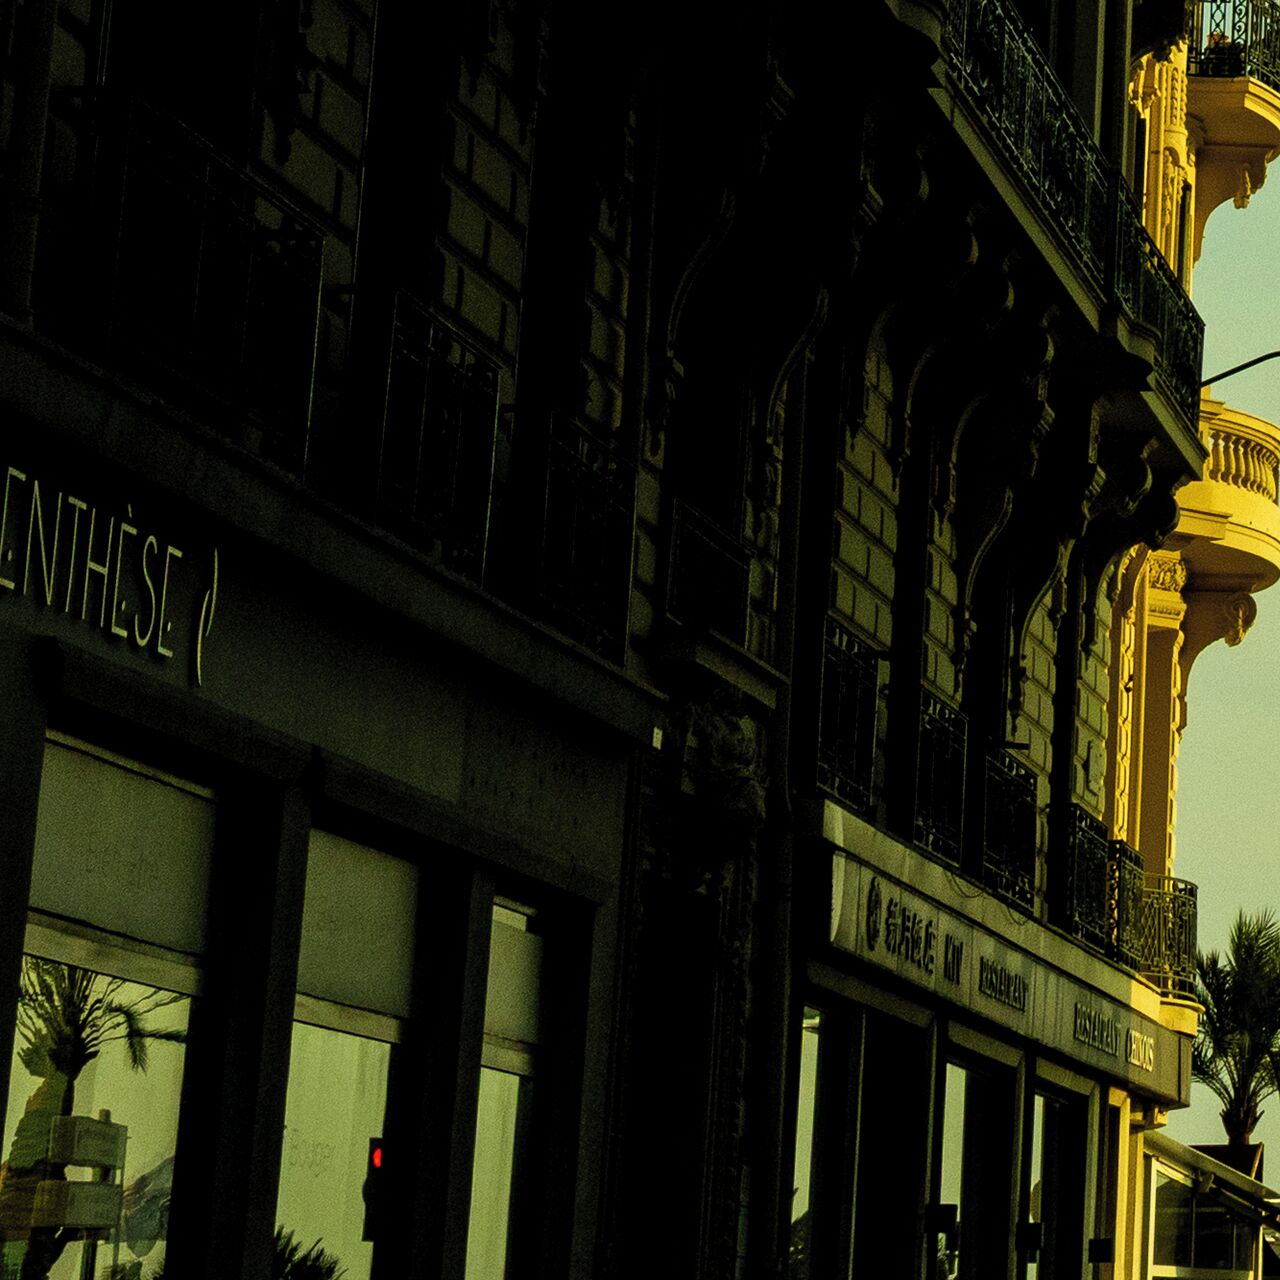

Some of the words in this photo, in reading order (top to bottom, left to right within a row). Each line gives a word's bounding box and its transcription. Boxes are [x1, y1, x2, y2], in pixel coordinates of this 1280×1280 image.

[0, 466, 183, 658] ENTHÈSE
[979, 956, 1027, 1013] RESTAURANT
[1074, 1002, 1121, 1058] RESTAURANT
[1126, 1028, 1153, 1072] CHINOIS
